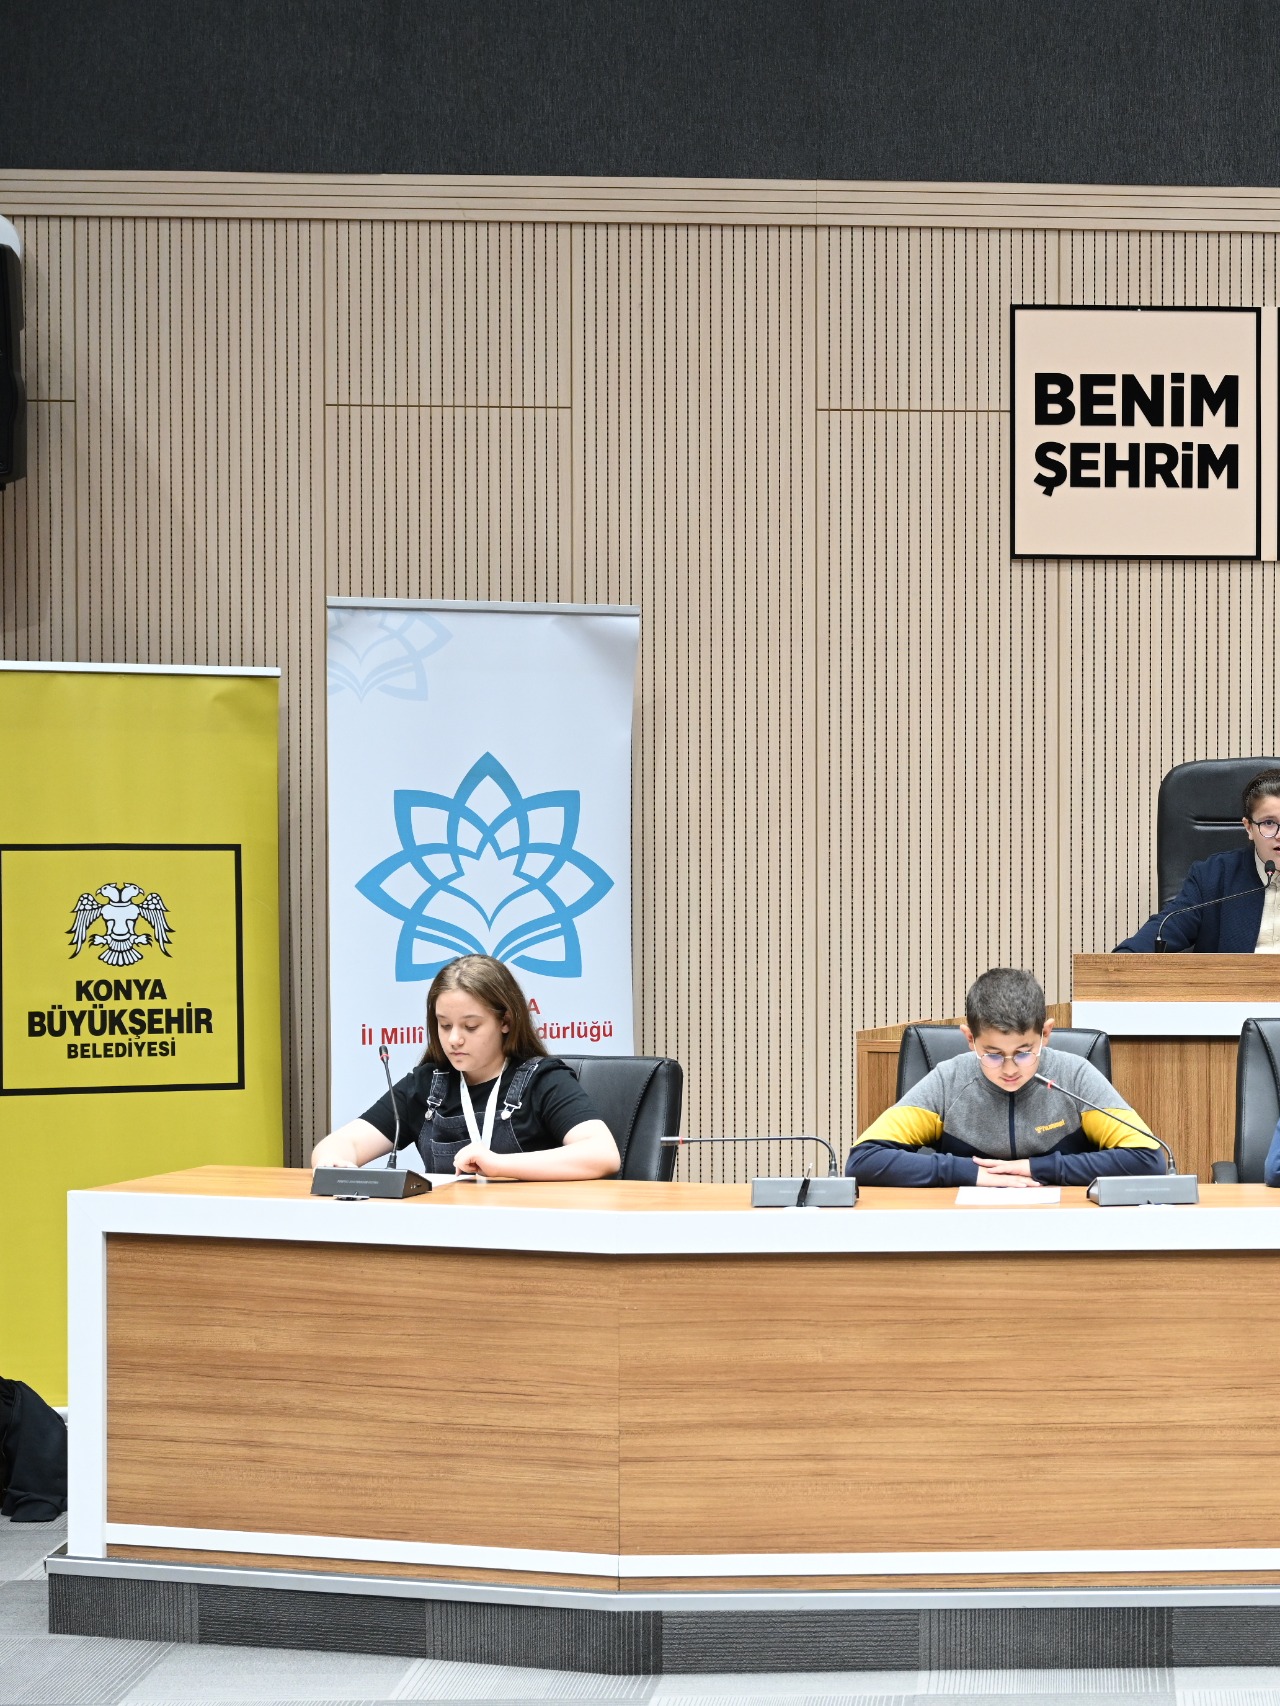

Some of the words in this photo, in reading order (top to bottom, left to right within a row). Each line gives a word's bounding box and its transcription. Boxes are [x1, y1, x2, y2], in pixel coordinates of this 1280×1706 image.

[75, 979, 168, 1002] KONYA
[27, 1002, 214, 1040] BÜYÜKŞEHİR
[361, 1023, 374, 1046] İl
[536, 1020, 613, 1043] dürlüğü
[66, 1036, 176, 1060] BELEDİYESİ
